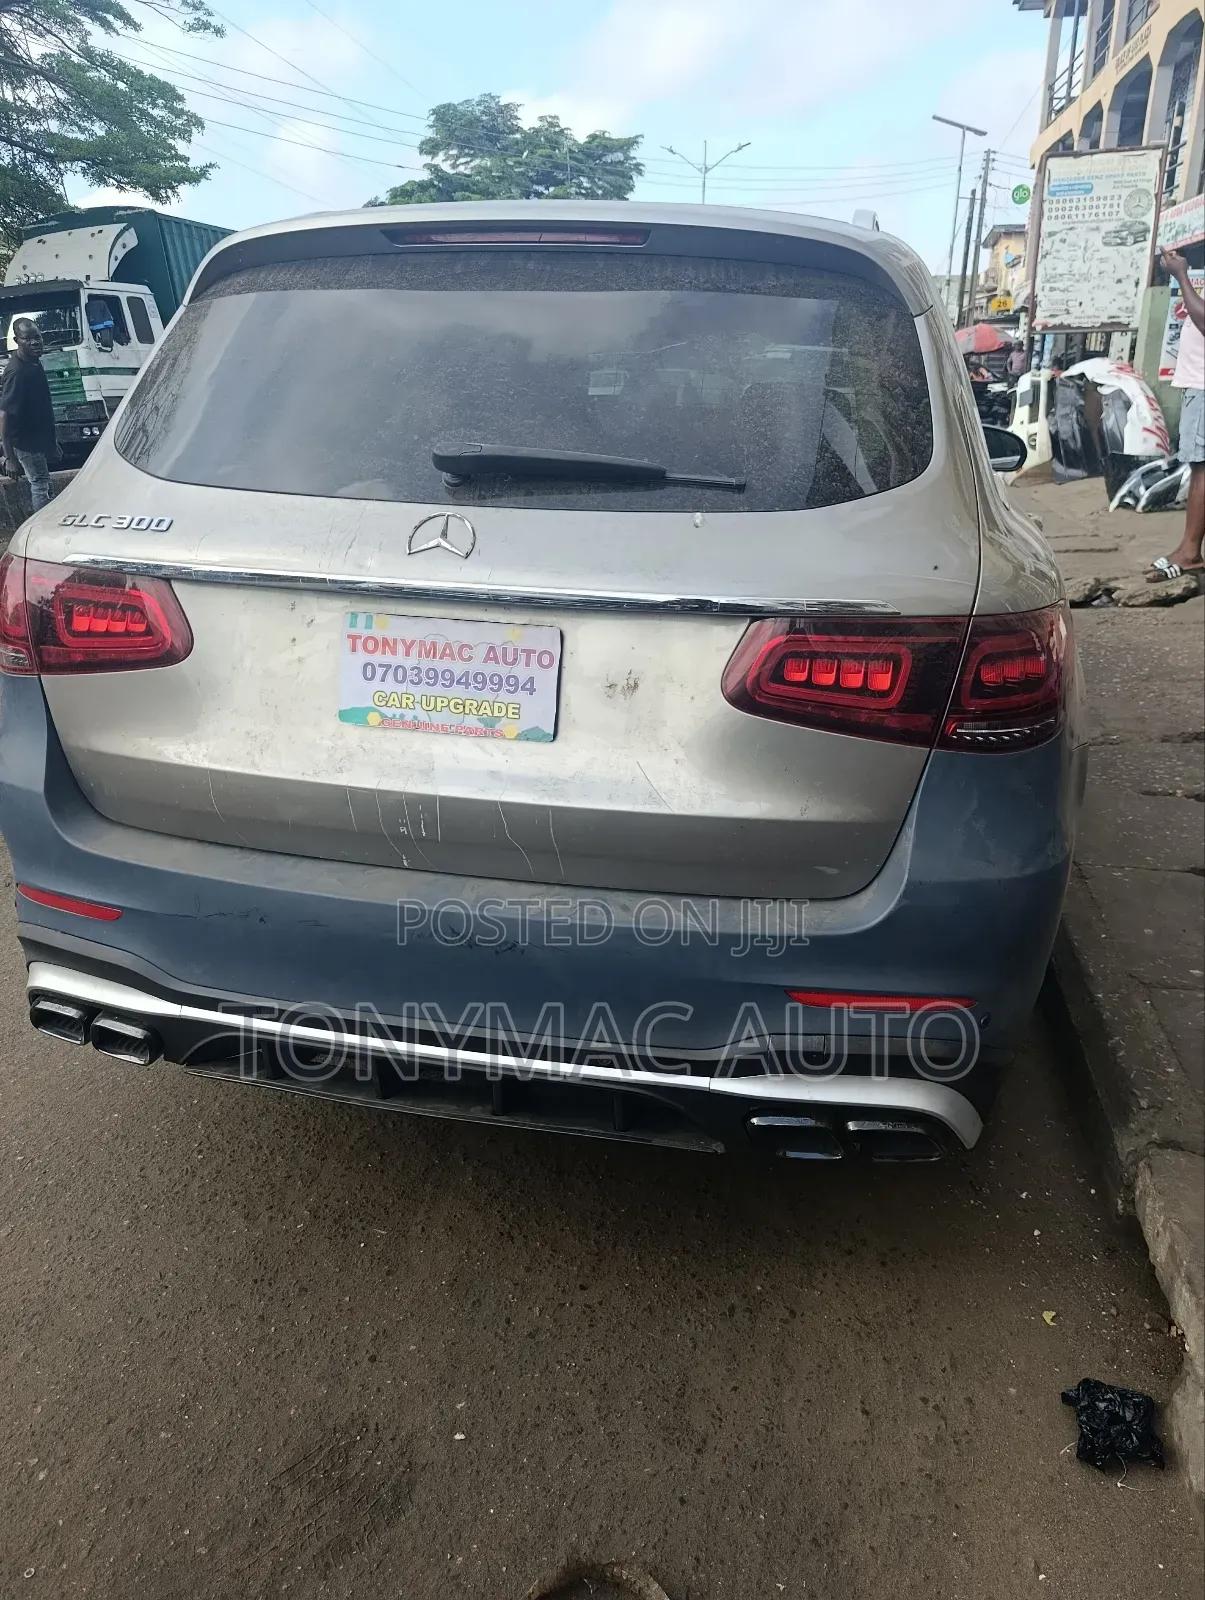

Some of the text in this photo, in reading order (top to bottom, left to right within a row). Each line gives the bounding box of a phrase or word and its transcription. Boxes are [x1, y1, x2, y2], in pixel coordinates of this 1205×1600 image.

[1013, 189, 1028, 201] glo
[997, 300, 1008, 308] 26
[58, 513, 173, 532] GLC 300
[346, 633, 556, 670] TONYMAC AUTO
[362, 661, 537, 696] 07039949994
[373, 691, 521, 719] CAR UPGRADE
[380, 718, 504, 738] GENUINE PARTS
